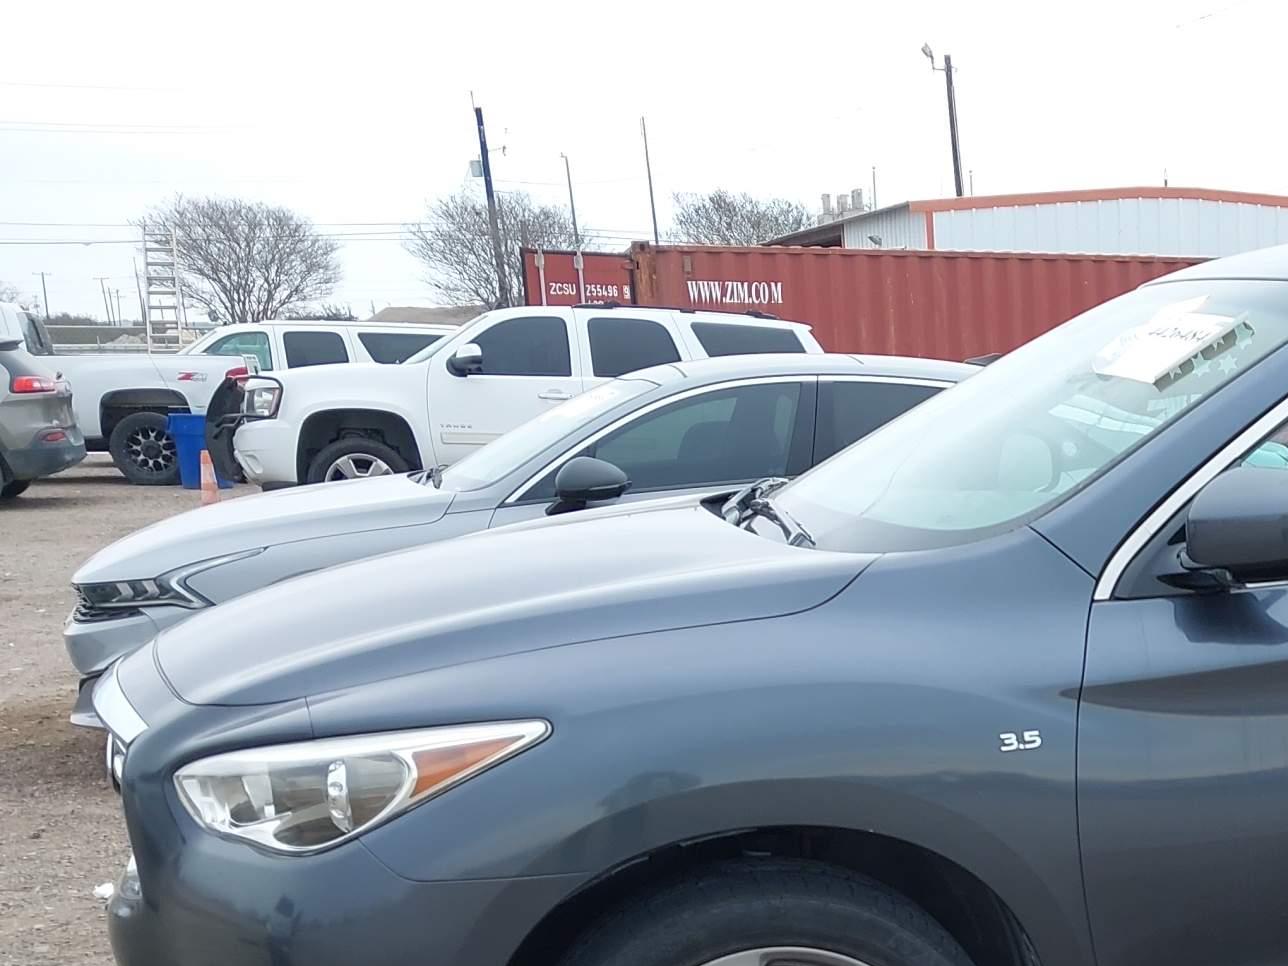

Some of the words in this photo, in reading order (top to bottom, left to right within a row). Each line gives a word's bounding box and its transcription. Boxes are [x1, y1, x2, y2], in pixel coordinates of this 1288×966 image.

[549, 282, 577, 295] ZCSU
[585, 284, 618, 297] 255496
[687, 280, 783, 304] WWW.ZIM.COM
[999, 729, 1042, 752] 3.5
